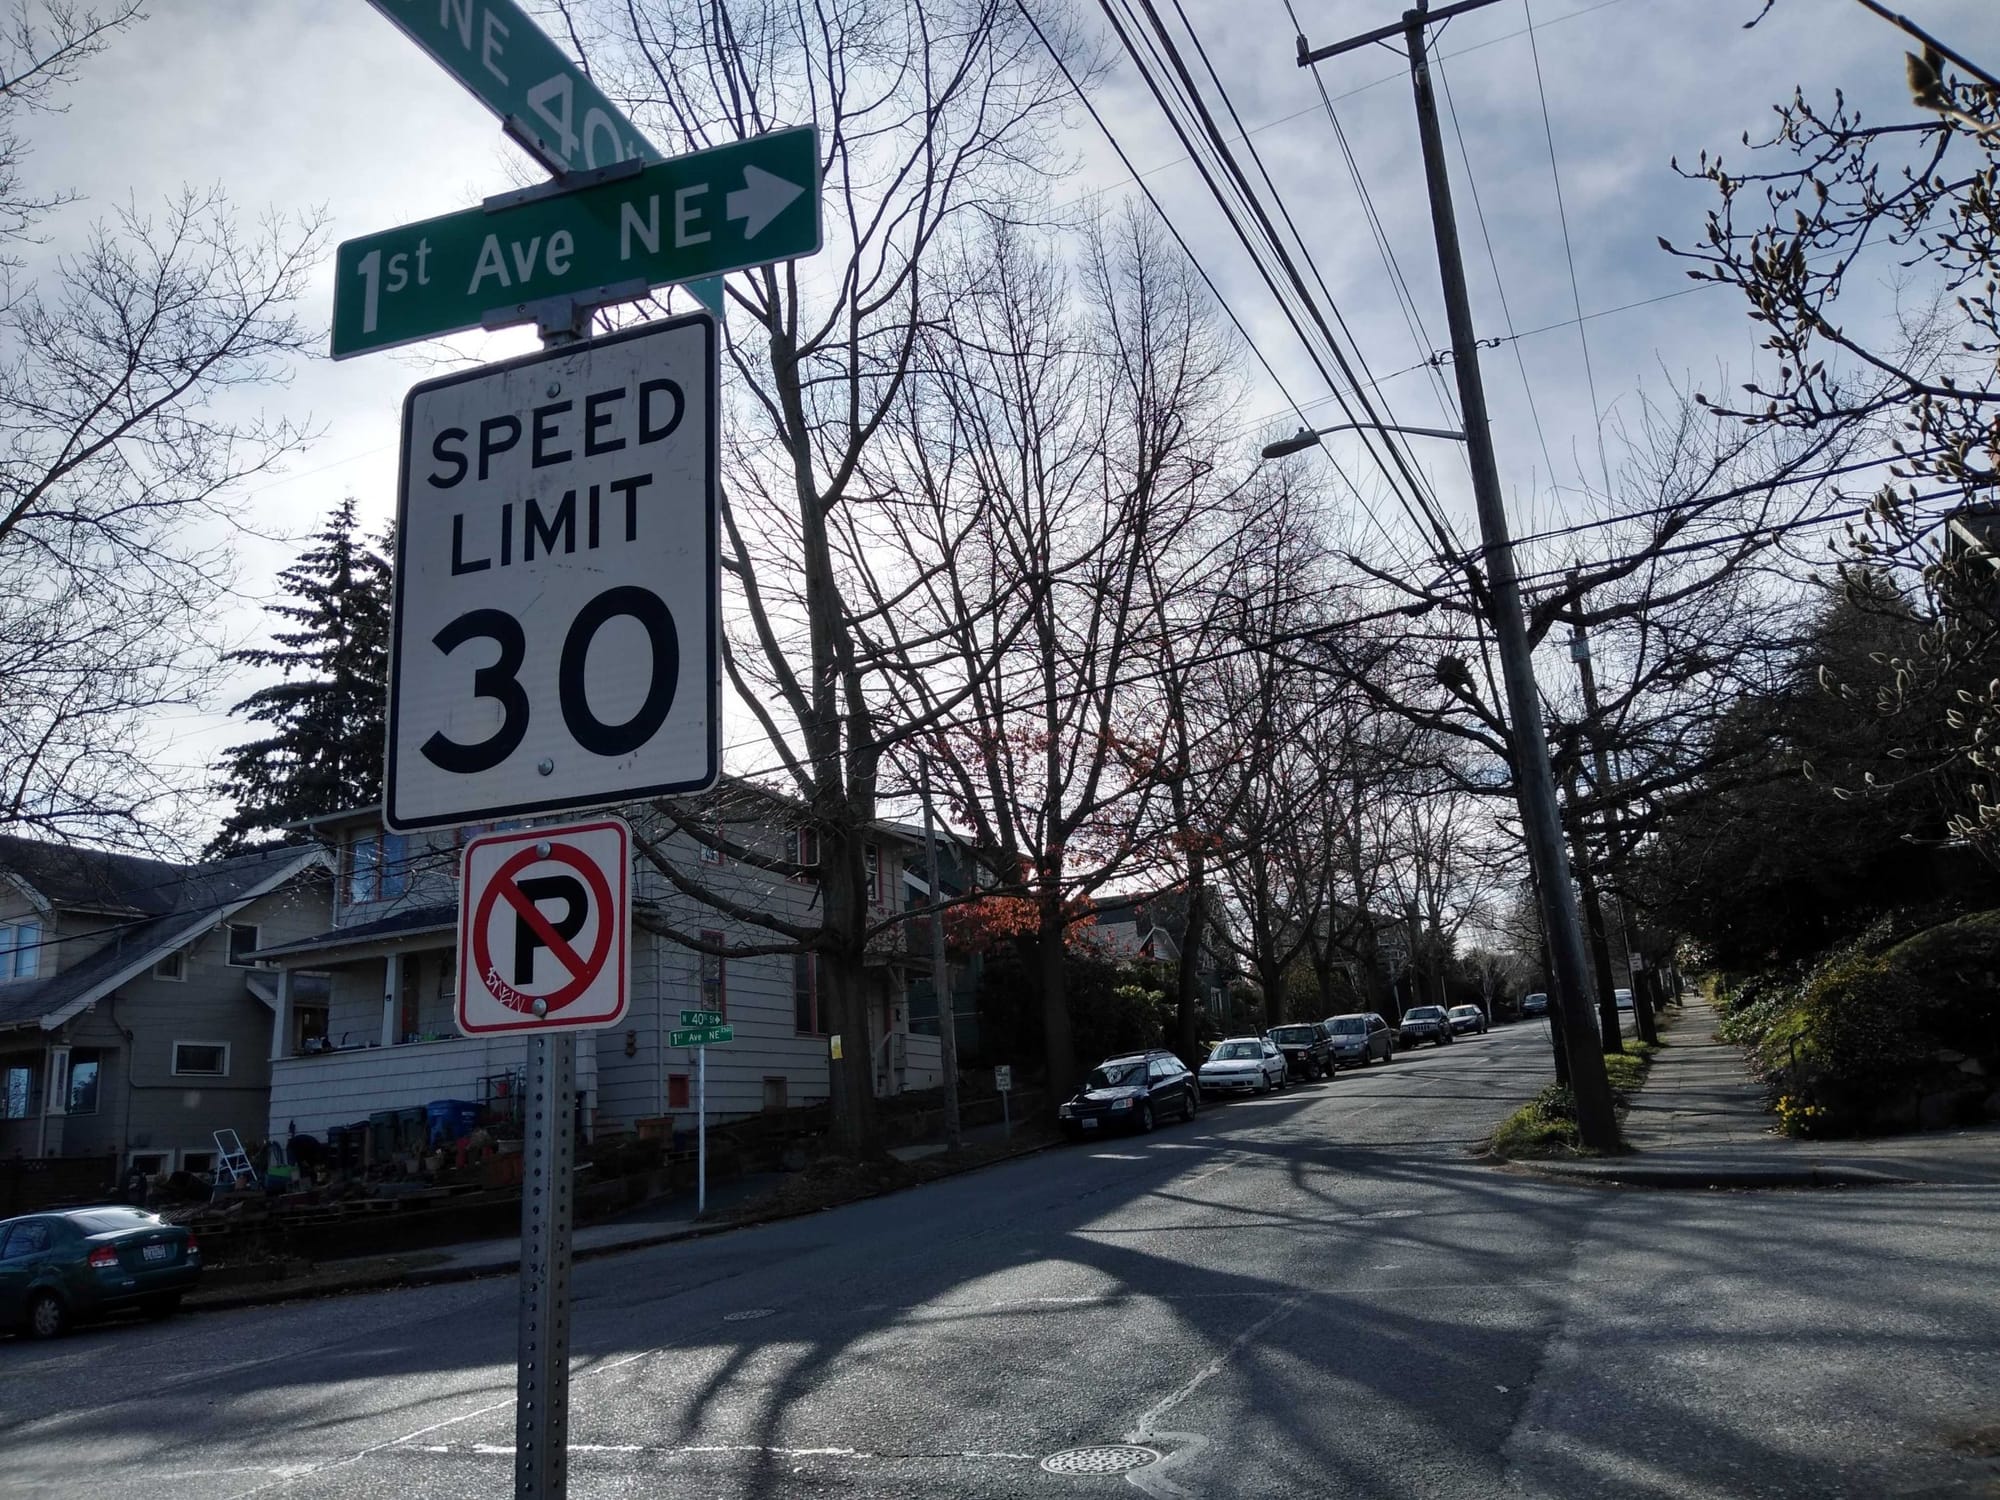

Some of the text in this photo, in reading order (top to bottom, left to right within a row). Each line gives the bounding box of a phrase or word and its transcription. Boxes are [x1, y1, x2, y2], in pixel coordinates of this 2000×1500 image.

[440, 0, 510, 87] NE
[357, 183, 712, 334] 1st Ave NE
[427, 378, 686, 489] SPEED
[451, 473, 653, 577] LIMIT
[420, 585, 680, 774] 30
[514, 875, 588, 986] P
[688, 1033, 702, 1042] Ave
[709, 1030, 720, 1040] NE
